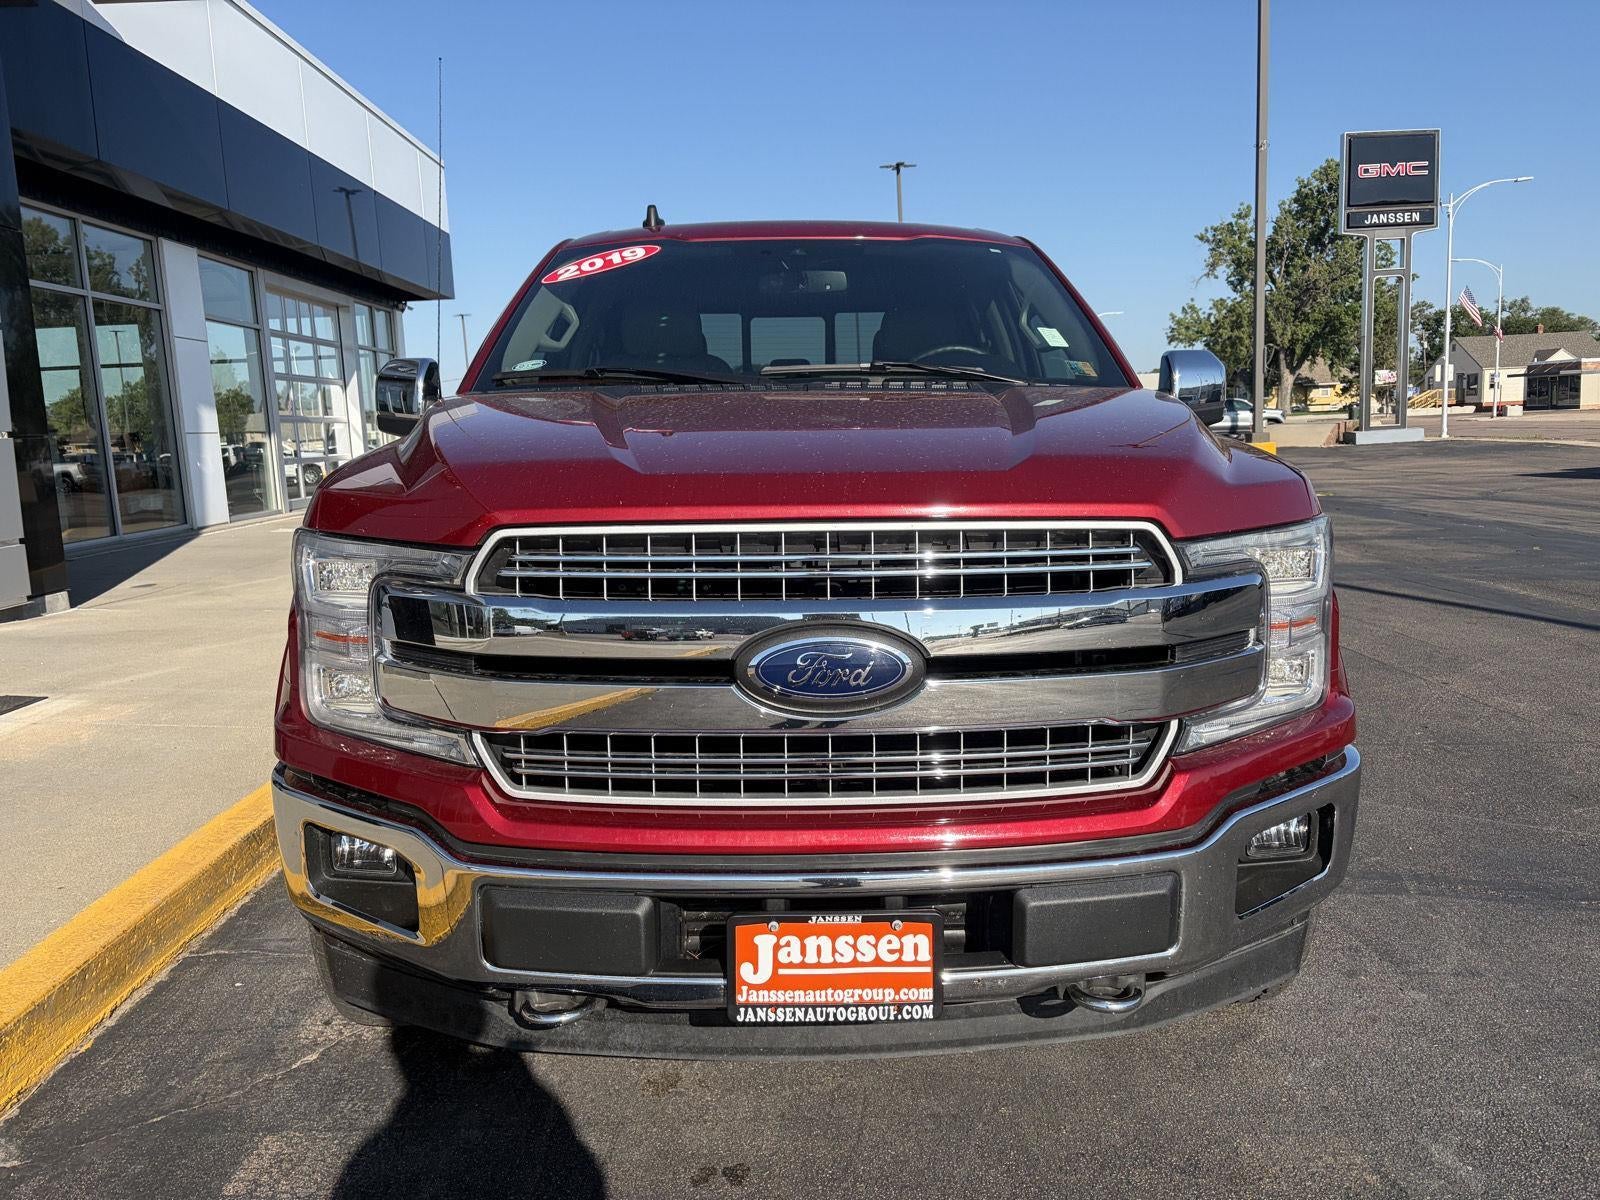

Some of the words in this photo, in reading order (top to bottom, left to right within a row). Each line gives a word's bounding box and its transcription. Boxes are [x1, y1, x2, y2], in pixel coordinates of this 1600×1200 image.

[1357, 161, 1428, 178] GMC
[1365, 212, 1420, 224] JANSSEN
[557, 247, 646, 281] 2019
[787, 651, 875, 688] Ford
[808, 916, 863, 924] JANSSEN
[740, 934, 931, 985] Janssen
[737, 985, 933, 1003] Janssenautogroup.com
[737, 1004, 933, 1022] JANSSENAUTOGROUP.COM
